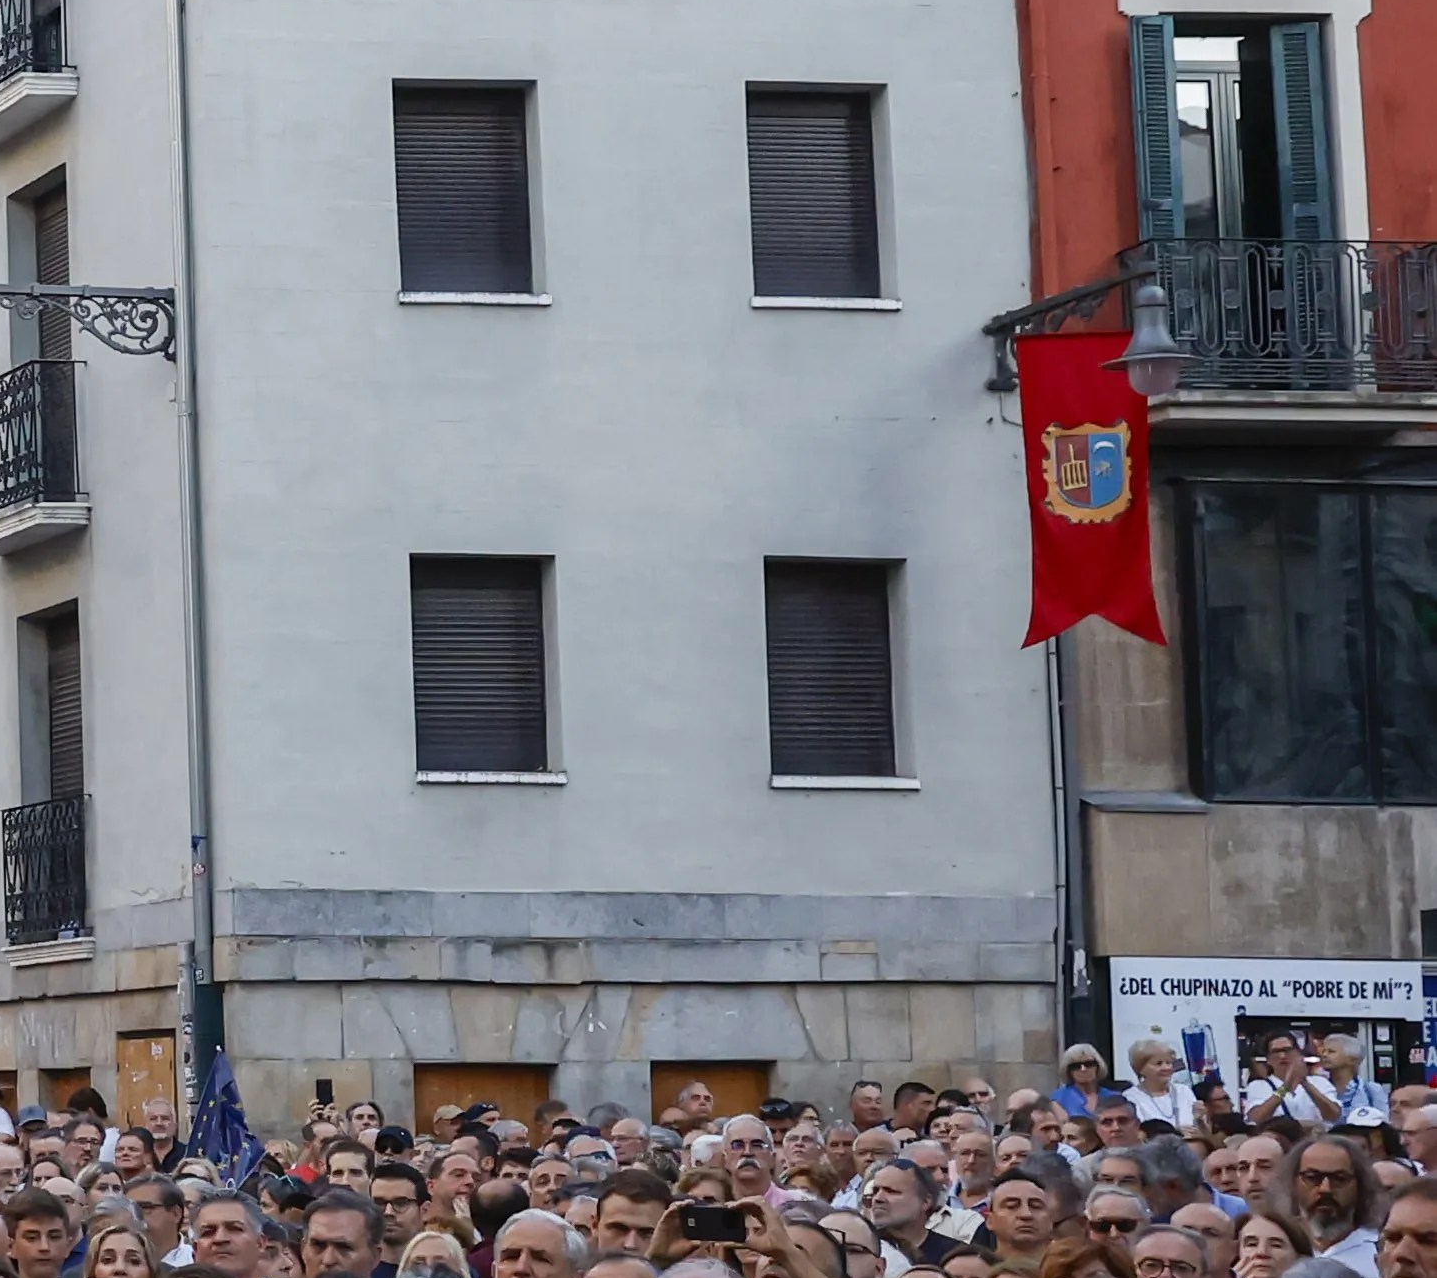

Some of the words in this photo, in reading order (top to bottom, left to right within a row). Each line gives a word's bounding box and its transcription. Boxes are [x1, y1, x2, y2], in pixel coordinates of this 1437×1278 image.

[1119, 977, 1156, 997] ¿DEL
[1162, 977, 1254, 998] CHUPINAZO
[1258, 979, 1278, 998] AL
[1349, 981, 1369, 1000] DE
